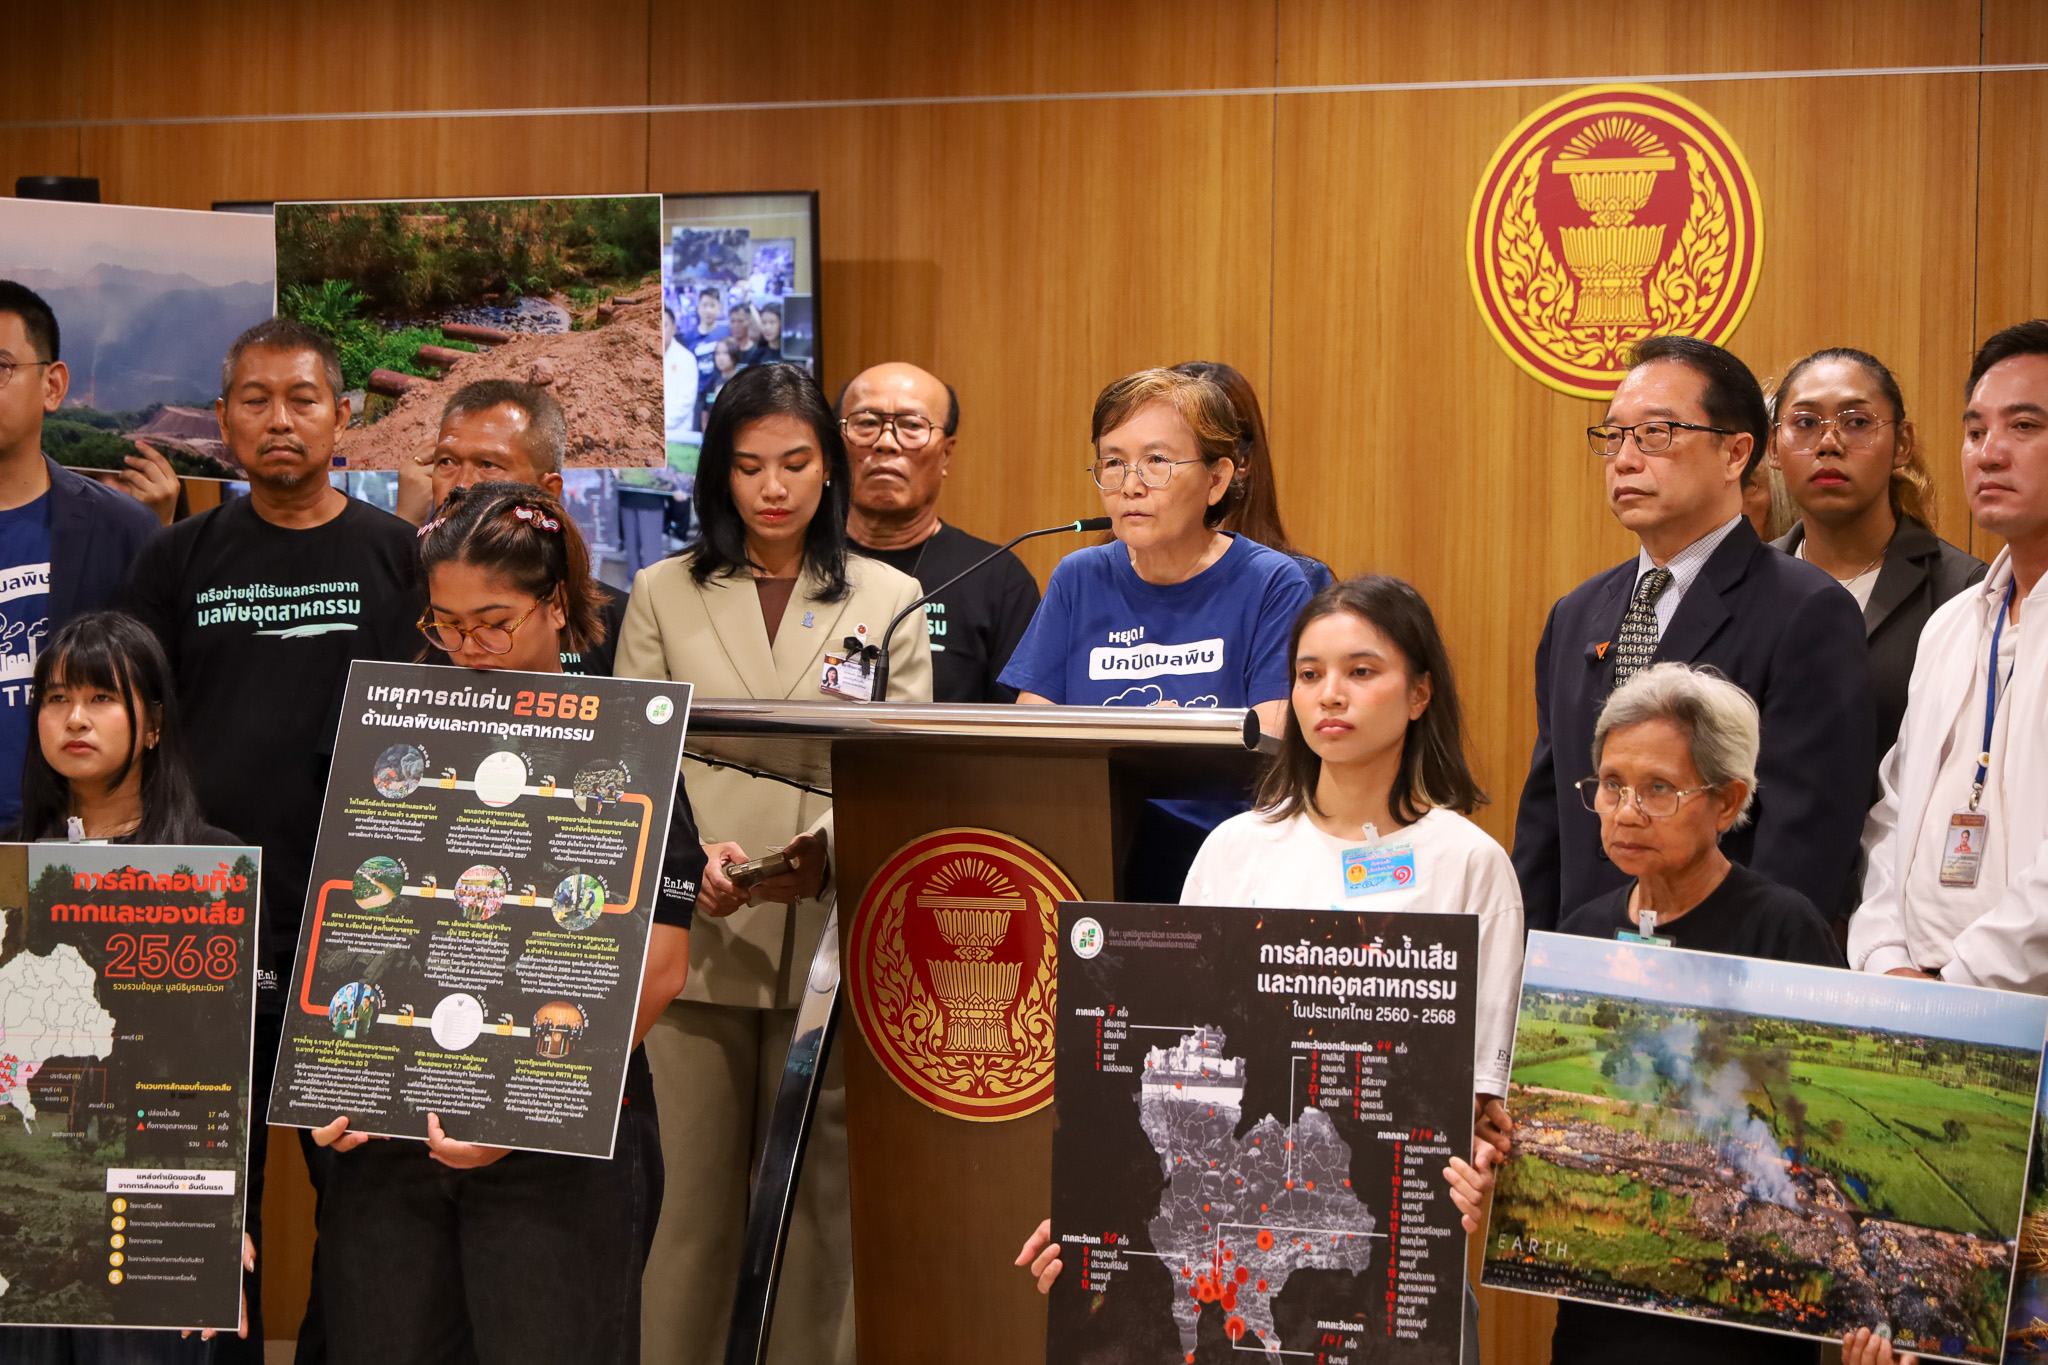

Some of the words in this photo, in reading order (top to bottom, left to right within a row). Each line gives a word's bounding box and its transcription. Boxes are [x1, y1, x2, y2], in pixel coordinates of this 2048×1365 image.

[196, 580, 359, 604] เครือข่ายผู้ได้รับผลกระทบจาก
[197, 598, 361, 627] มลพิษอุตสาหกรรม
[1108, 626, 1145, 647] หยุด!
[1101, 649, 1215, 670] ปกปิดมลพิษ
[366, 685, 511, 711] เหตุการณ์เด่น
[512, 690, 600, 721] 2568
[360, 708, 595, 741] ด้านมลพิษและกากอุตสาหกรรม
[73, 862, 247, 892] การลักลอบทิ้ง
[50, 899, 245, 925] กากและของเสีย
[105, 933, 237, 980] 2568
[1260, 935, 1458, 971] การลักลอบทิ้งน้ำเสีย
[1257, 973, 1456, 1004] และกากอุตสาหกรรม
[1075, 1006, 1105, 1017] ภาคเหนือ
[1108, 1004, 1115, 1016] 7
[1292, 1000, 1373, 1021] ในประเทศไทย
[1375, 1007, 1410, 1022] 2560
[1421, 1009, 1456, 1024] 2568
[1096, 1017, 1102, 1027] 2
[1096, 1028, 1101, 1038] 2
[1096, 1039, 1100, 1049] 1
[1291, 1040, 1373, 1052] ภาคตะวันออกเฉียงเหนือ
[1096, 1050, 1100, 1060] 1
[1312, 1050, 1318, 1060] 3
[1355, 1052, 1361, 1063] 2
[1096, 1061, 1100, 1071] 1
[1311, 1061, 1317, 1072] 4
[1356, 1063, 1360, 1073] 1
[1311, 1073, 1317, 1083] 2
[1355, 1075, 1360, 1085] 1
[1308, 1084, 1319, 1094] 23
[1354, 1086, 1360, 1097] 2
[1311, 1096, 1315, 1105] 1
[1353, 1098, 1359, 1108] 4
[1354, 1109, 1358, 1119] 1
[1377, 1131, 1410, 1141] ภาคกลาง
[1395, 1164, 1399, 1174] 1
[1391, 1176, 1401, 1186] 10
[1393, 1187, 1398, 1197] 2
[1062, 1233, 1101, 1245] ภาคตะวันตก
[1103, 1231, 1118, 1244] 30
[1498, 1233, 1568, 1258] EARTH
[1083, 1257, 1088, 1267] 5
[1082, 1268, 1088, 1278] 4
[1081, 1279, 1090, 1290] 12
[1317, 1319, 1364, 1332] ภาคตะวันออก
